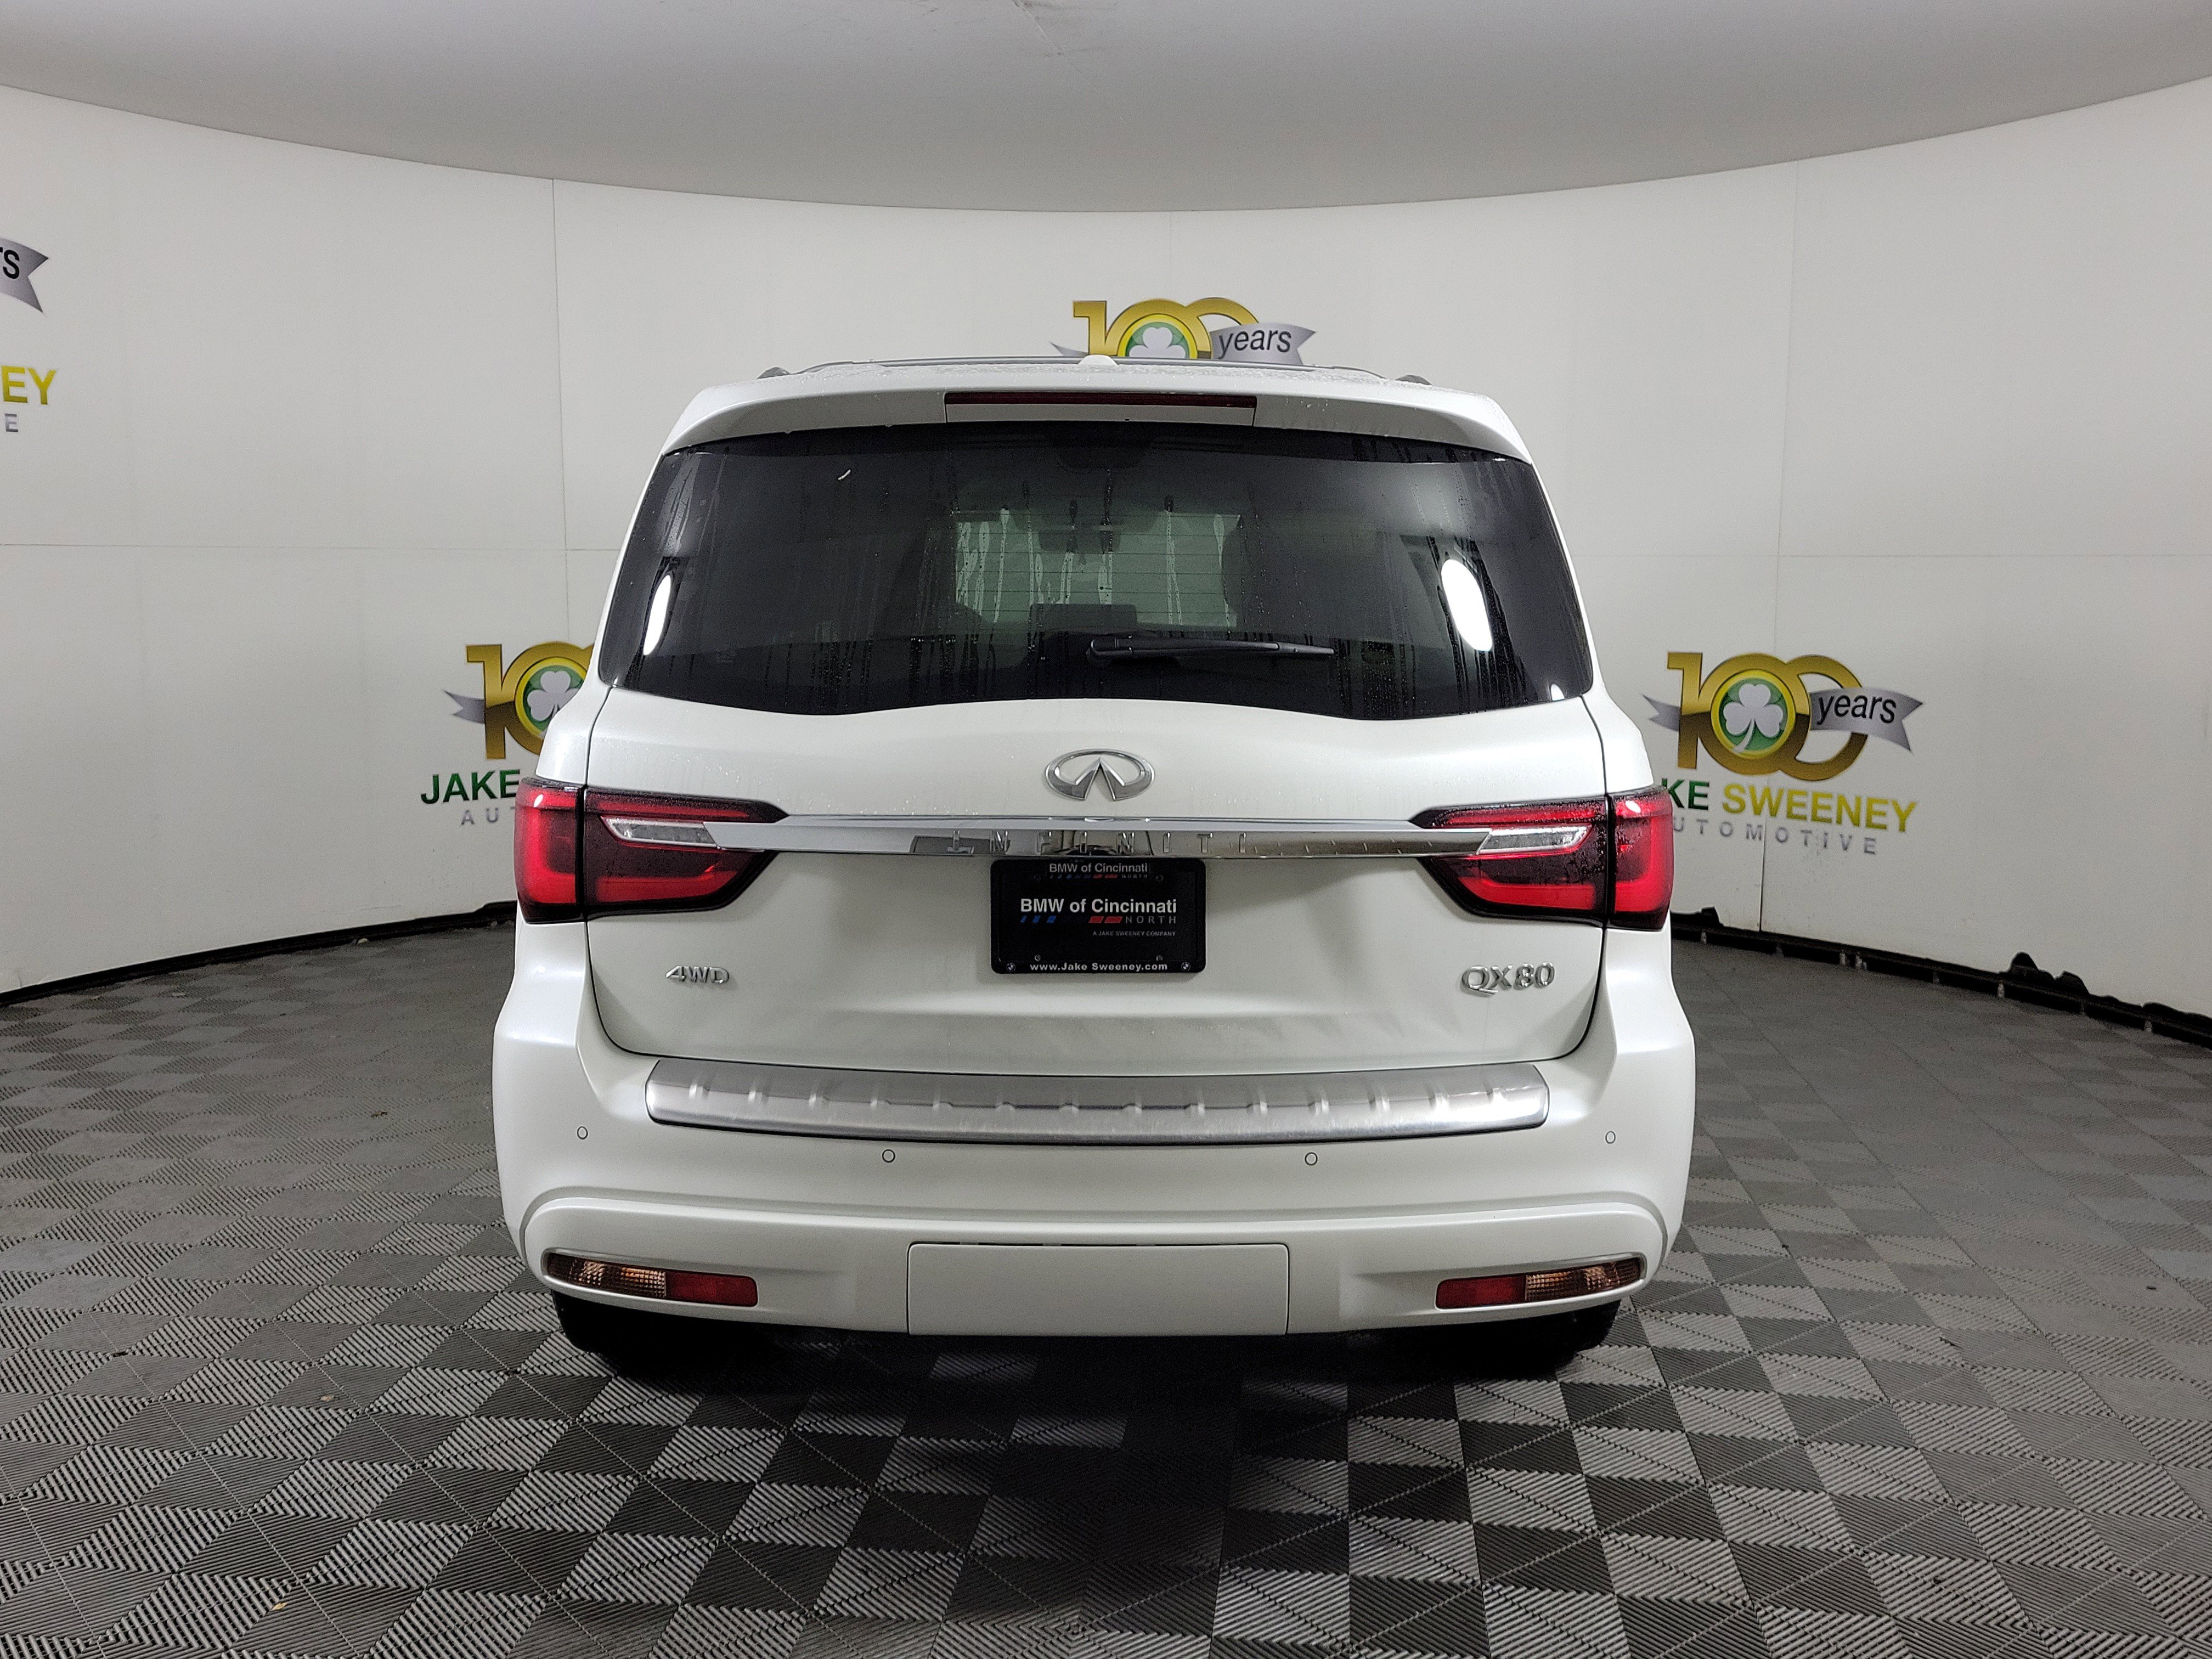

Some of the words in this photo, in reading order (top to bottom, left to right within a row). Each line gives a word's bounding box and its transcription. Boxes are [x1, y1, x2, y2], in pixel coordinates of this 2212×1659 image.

[1218, 329, 1292, 359] years
[466, 641, 595, 760] 10
[1816, 694, 1897, 725] years
[1667, 652, 1868, 781] 100
[420, 769, 520, 804] JAKE
[1661, 778, 1709, 810] KE
[1722, 783, 1917, 832] SWEENEY
[1673, 816, 1877, 854] UTOMOTIVE
[1049, 863, 1078, 873] BMW
[1081, 862, 1092, 873] of
[1094, 862, 1148, 873] Cincinnati
[1020, 898, 1064, 913] BMW
[1069, 898, 1087, 913] of
[1091, 898, 1177, 913] Cincinnati
[1125, 915, 1177, 924] NORTH
[665, 965, 730, 984] 4WD
[1030, 962, 1088, 970] www.Jake
[1092, 962, 1168, 972] Sweeney.com
[1461, 962, 1555, 996] QX80
